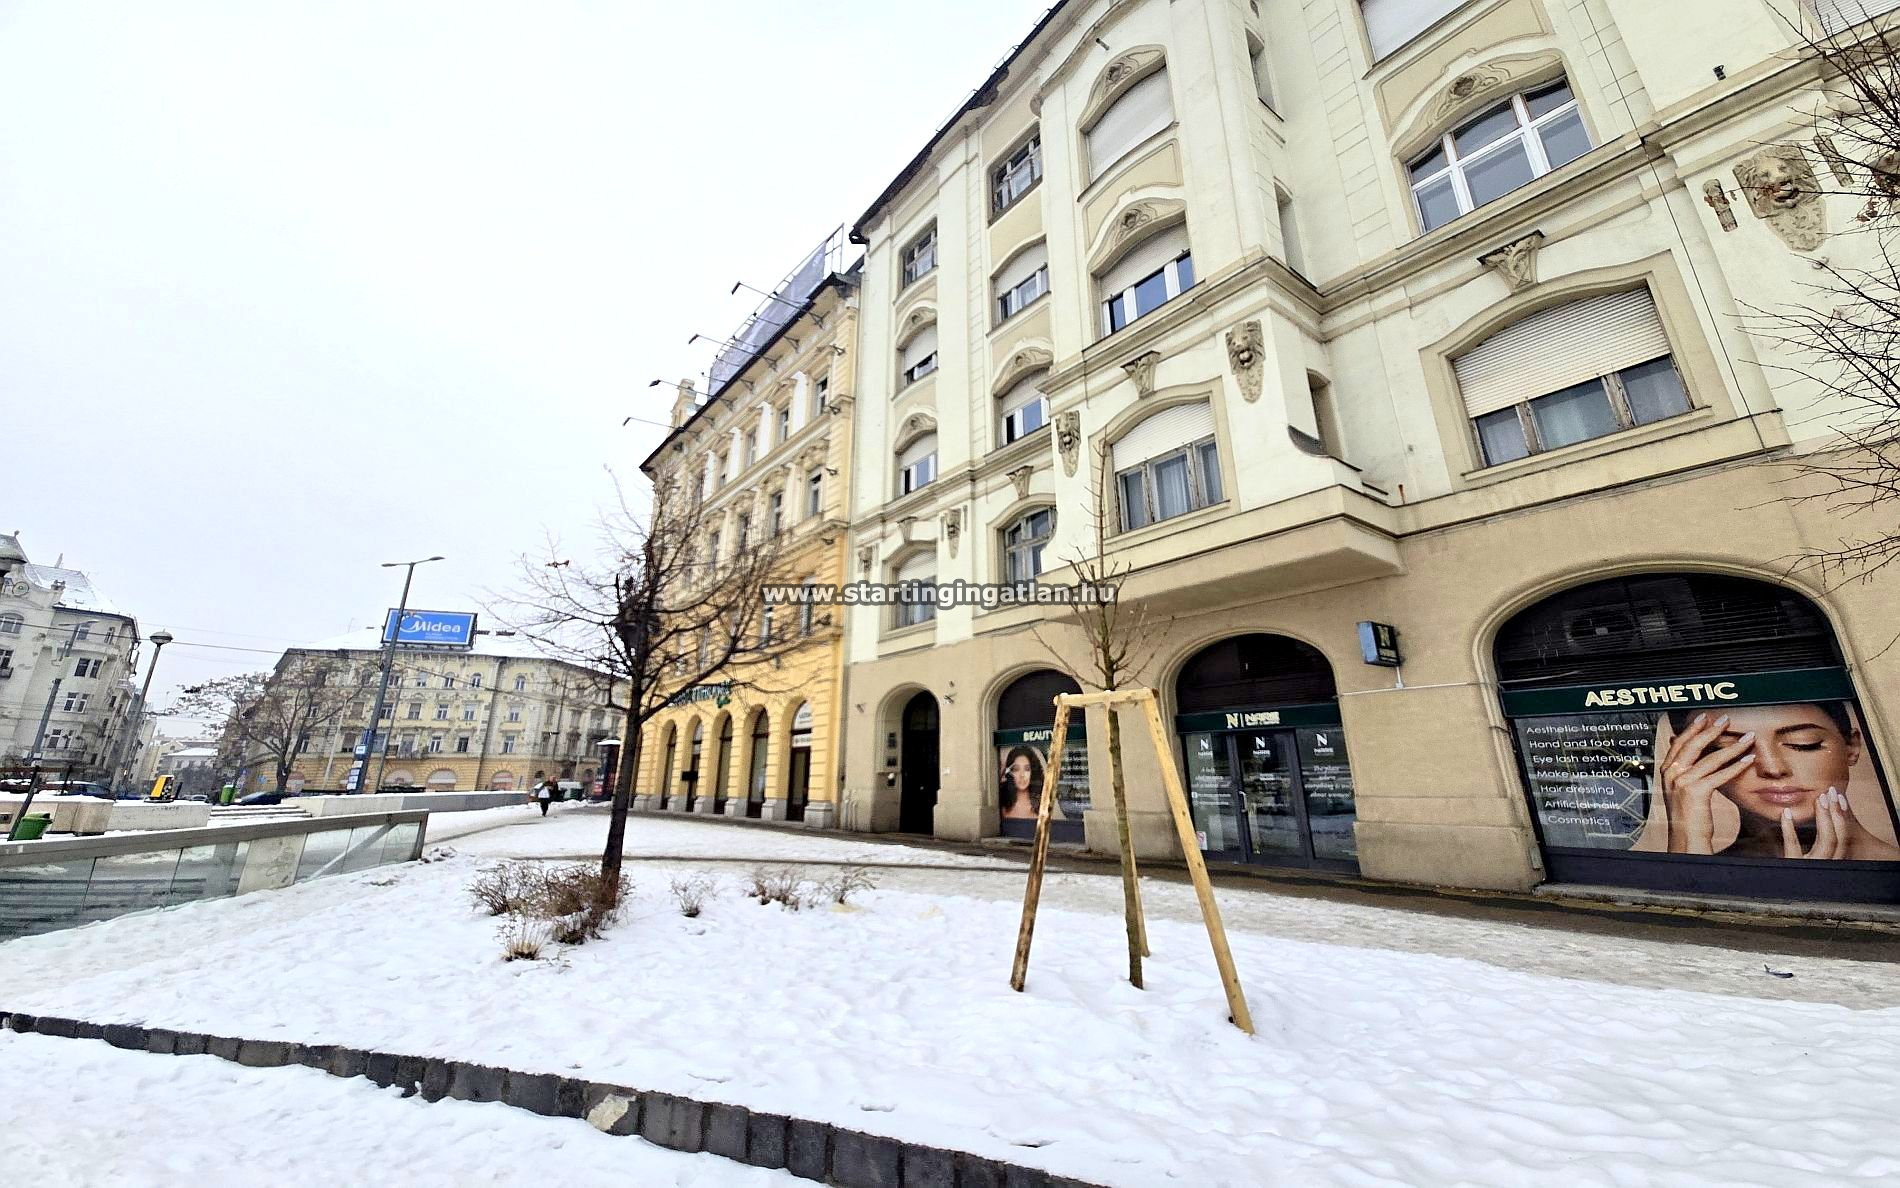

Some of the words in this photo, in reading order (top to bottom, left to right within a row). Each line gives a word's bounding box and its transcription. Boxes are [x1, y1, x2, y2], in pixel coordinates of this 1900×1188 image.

[409, 620, 461, 633] Midea
[1585, 682, 1738, 707] AESTHETIC
[1225, 713, 1239, 729] N
[1526, 724, 1579, 734] Aesthetic
[1581, 722, 1649, 732] treatments
[1255, 736, 1266, 749] N
[1316, 733, 1328, 746] N
[1529, 740, 1560, 748] Hand
[1563, 739, 1587, 748] and
[1590, 738, 1615, 747] foot
[1618, 738, 1649, 746] care
[1532, 755, 1553, 764] Eye
[1556, 755, 1579, 763] lash
[1582, 754, 1641, 763] extension
[1536, 770, 1569, 778] Make
[1572, 771, 1588, 779] up
[1591, 769, 1630, 778] tattoo
[1540, 785, 1562, 793] Hair
[1565, 784, 1615, 795] dressing
[1545, 800, 1590, 809] Artificial
[1592, 801, 1620, 810] nails
[1548, 815, 1610, 826] Cosmetics
